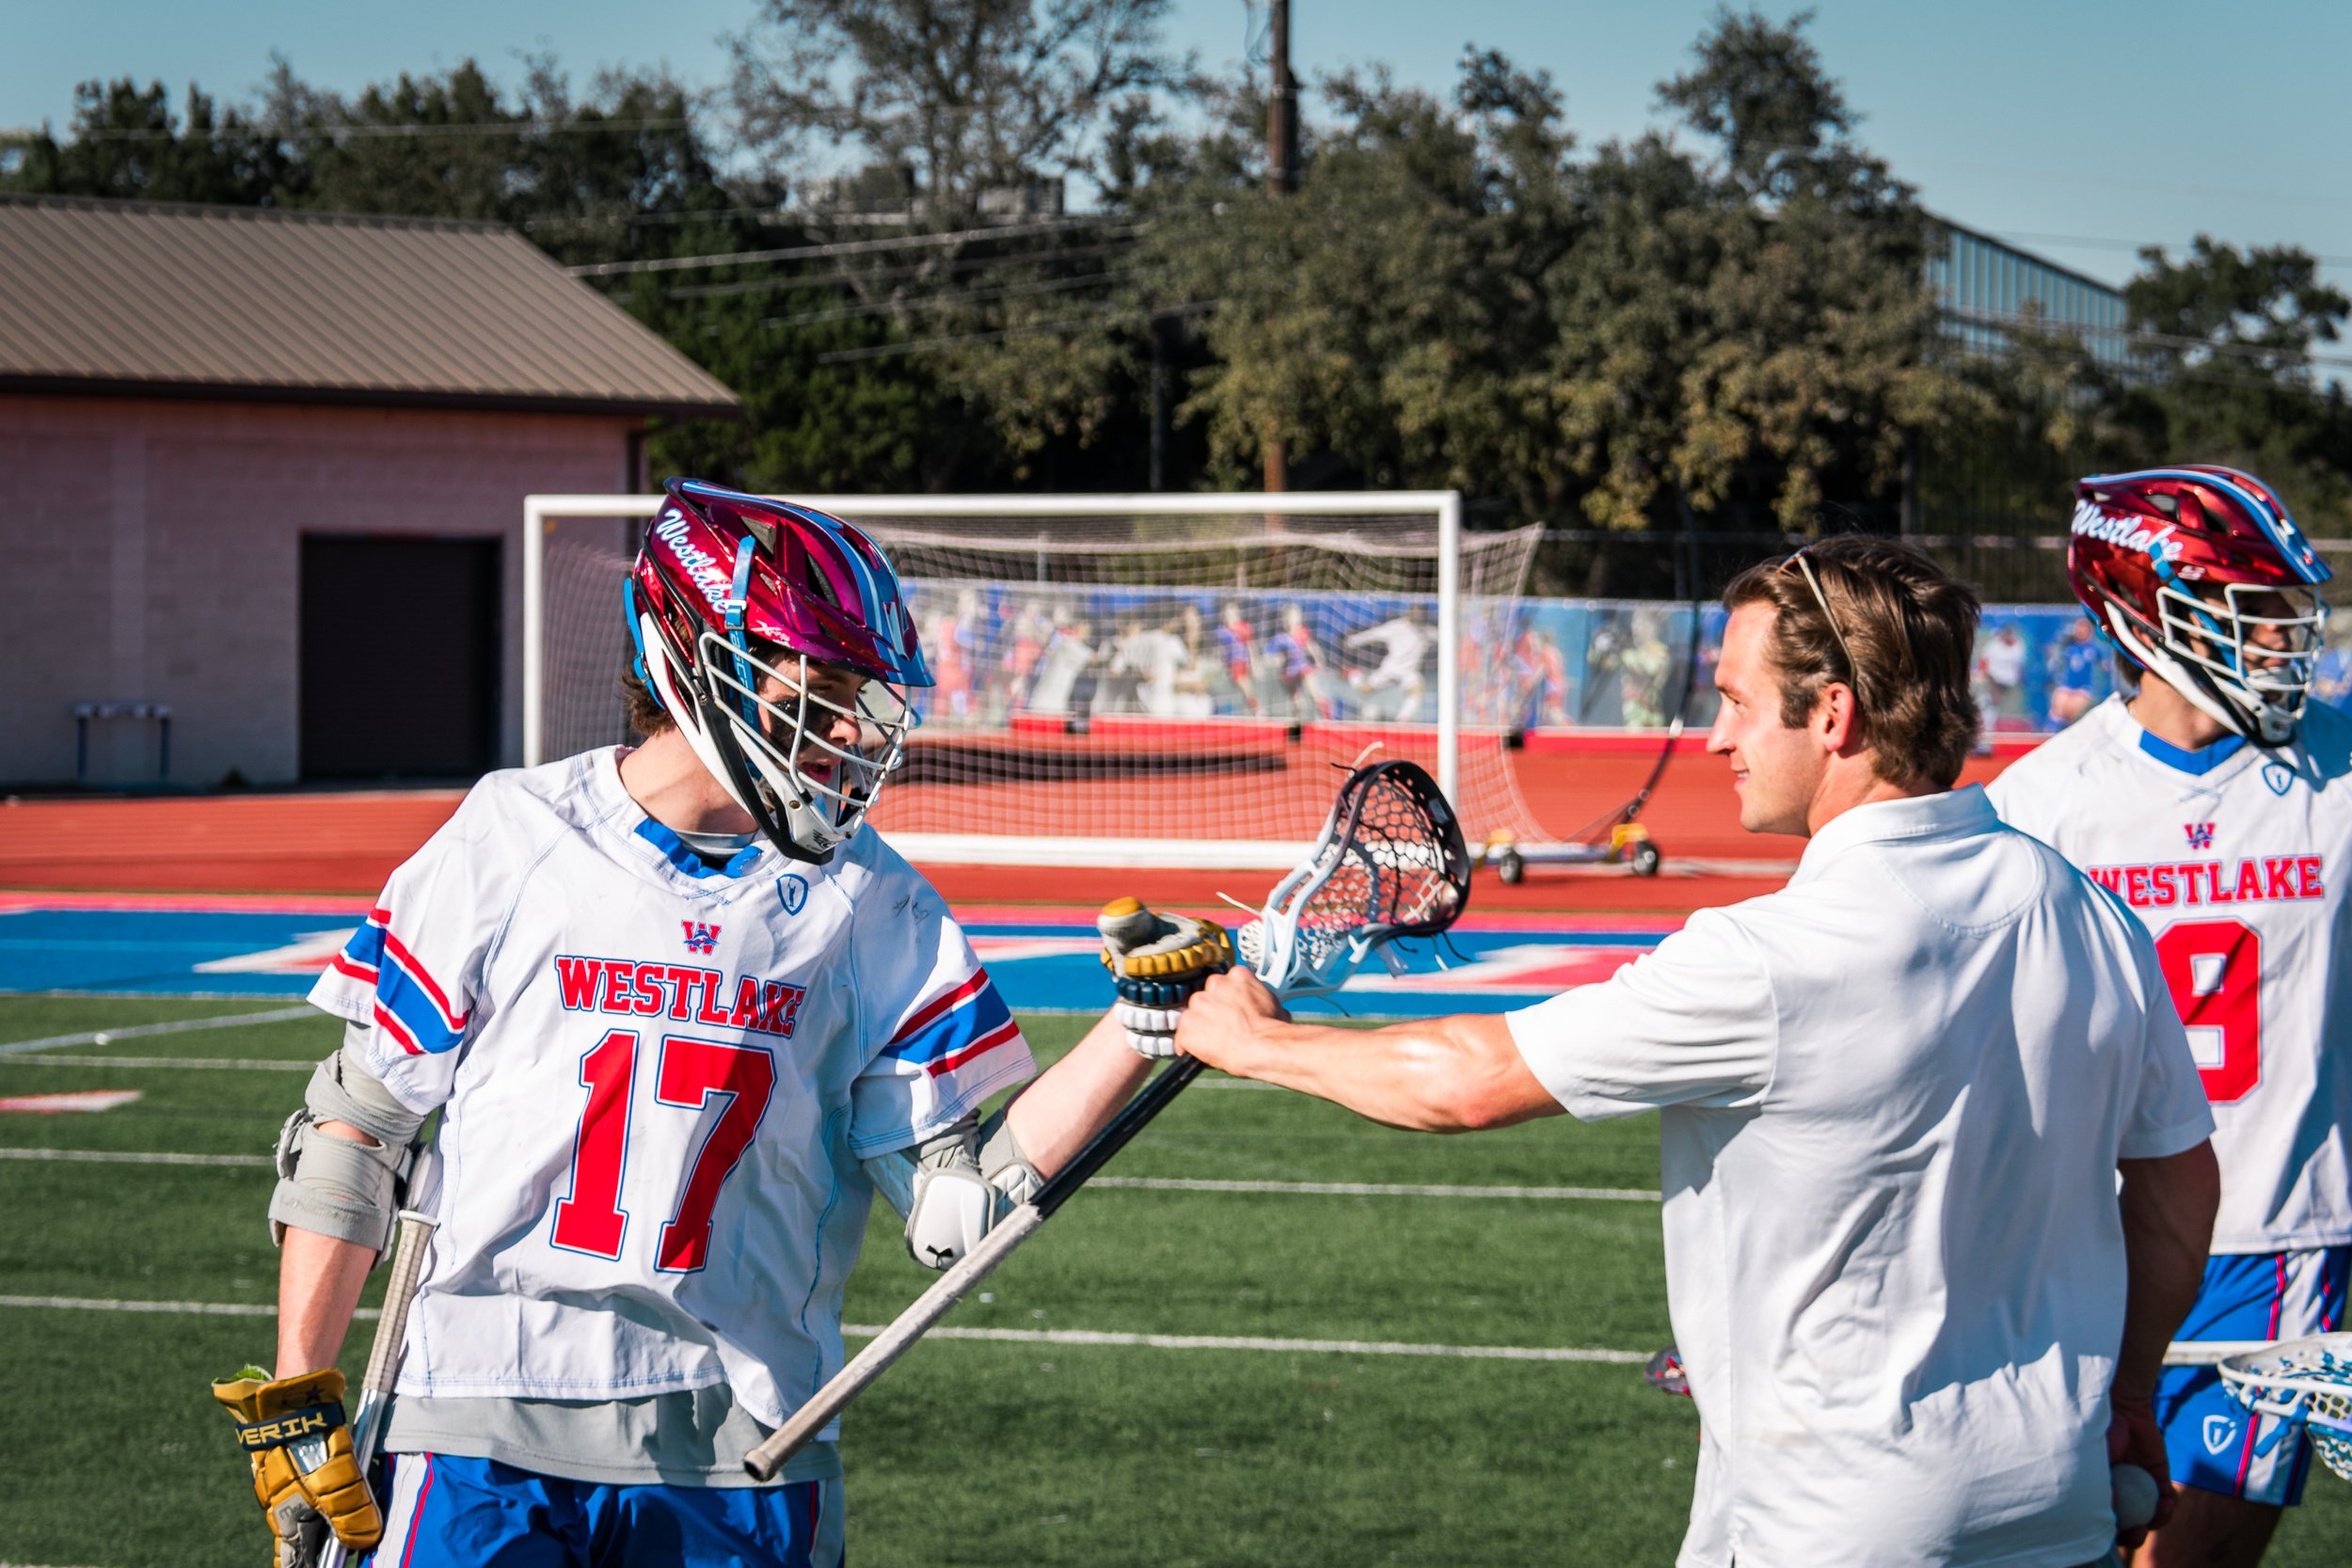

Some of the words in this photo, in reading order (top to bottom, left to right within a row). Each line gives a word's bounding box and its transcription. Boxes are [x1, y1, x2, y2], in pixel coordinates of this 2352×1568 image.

[656, 508, 732, 614] Westlake
[2071, 498, 2184, 562] Westlake
[554, 955, 807, 1039] WESTLAKE
[2153, 915, 2263, 1106] 9
[549, 1028, 778, 1275] 17
[234, 1412, 327, 1446] VERIK
